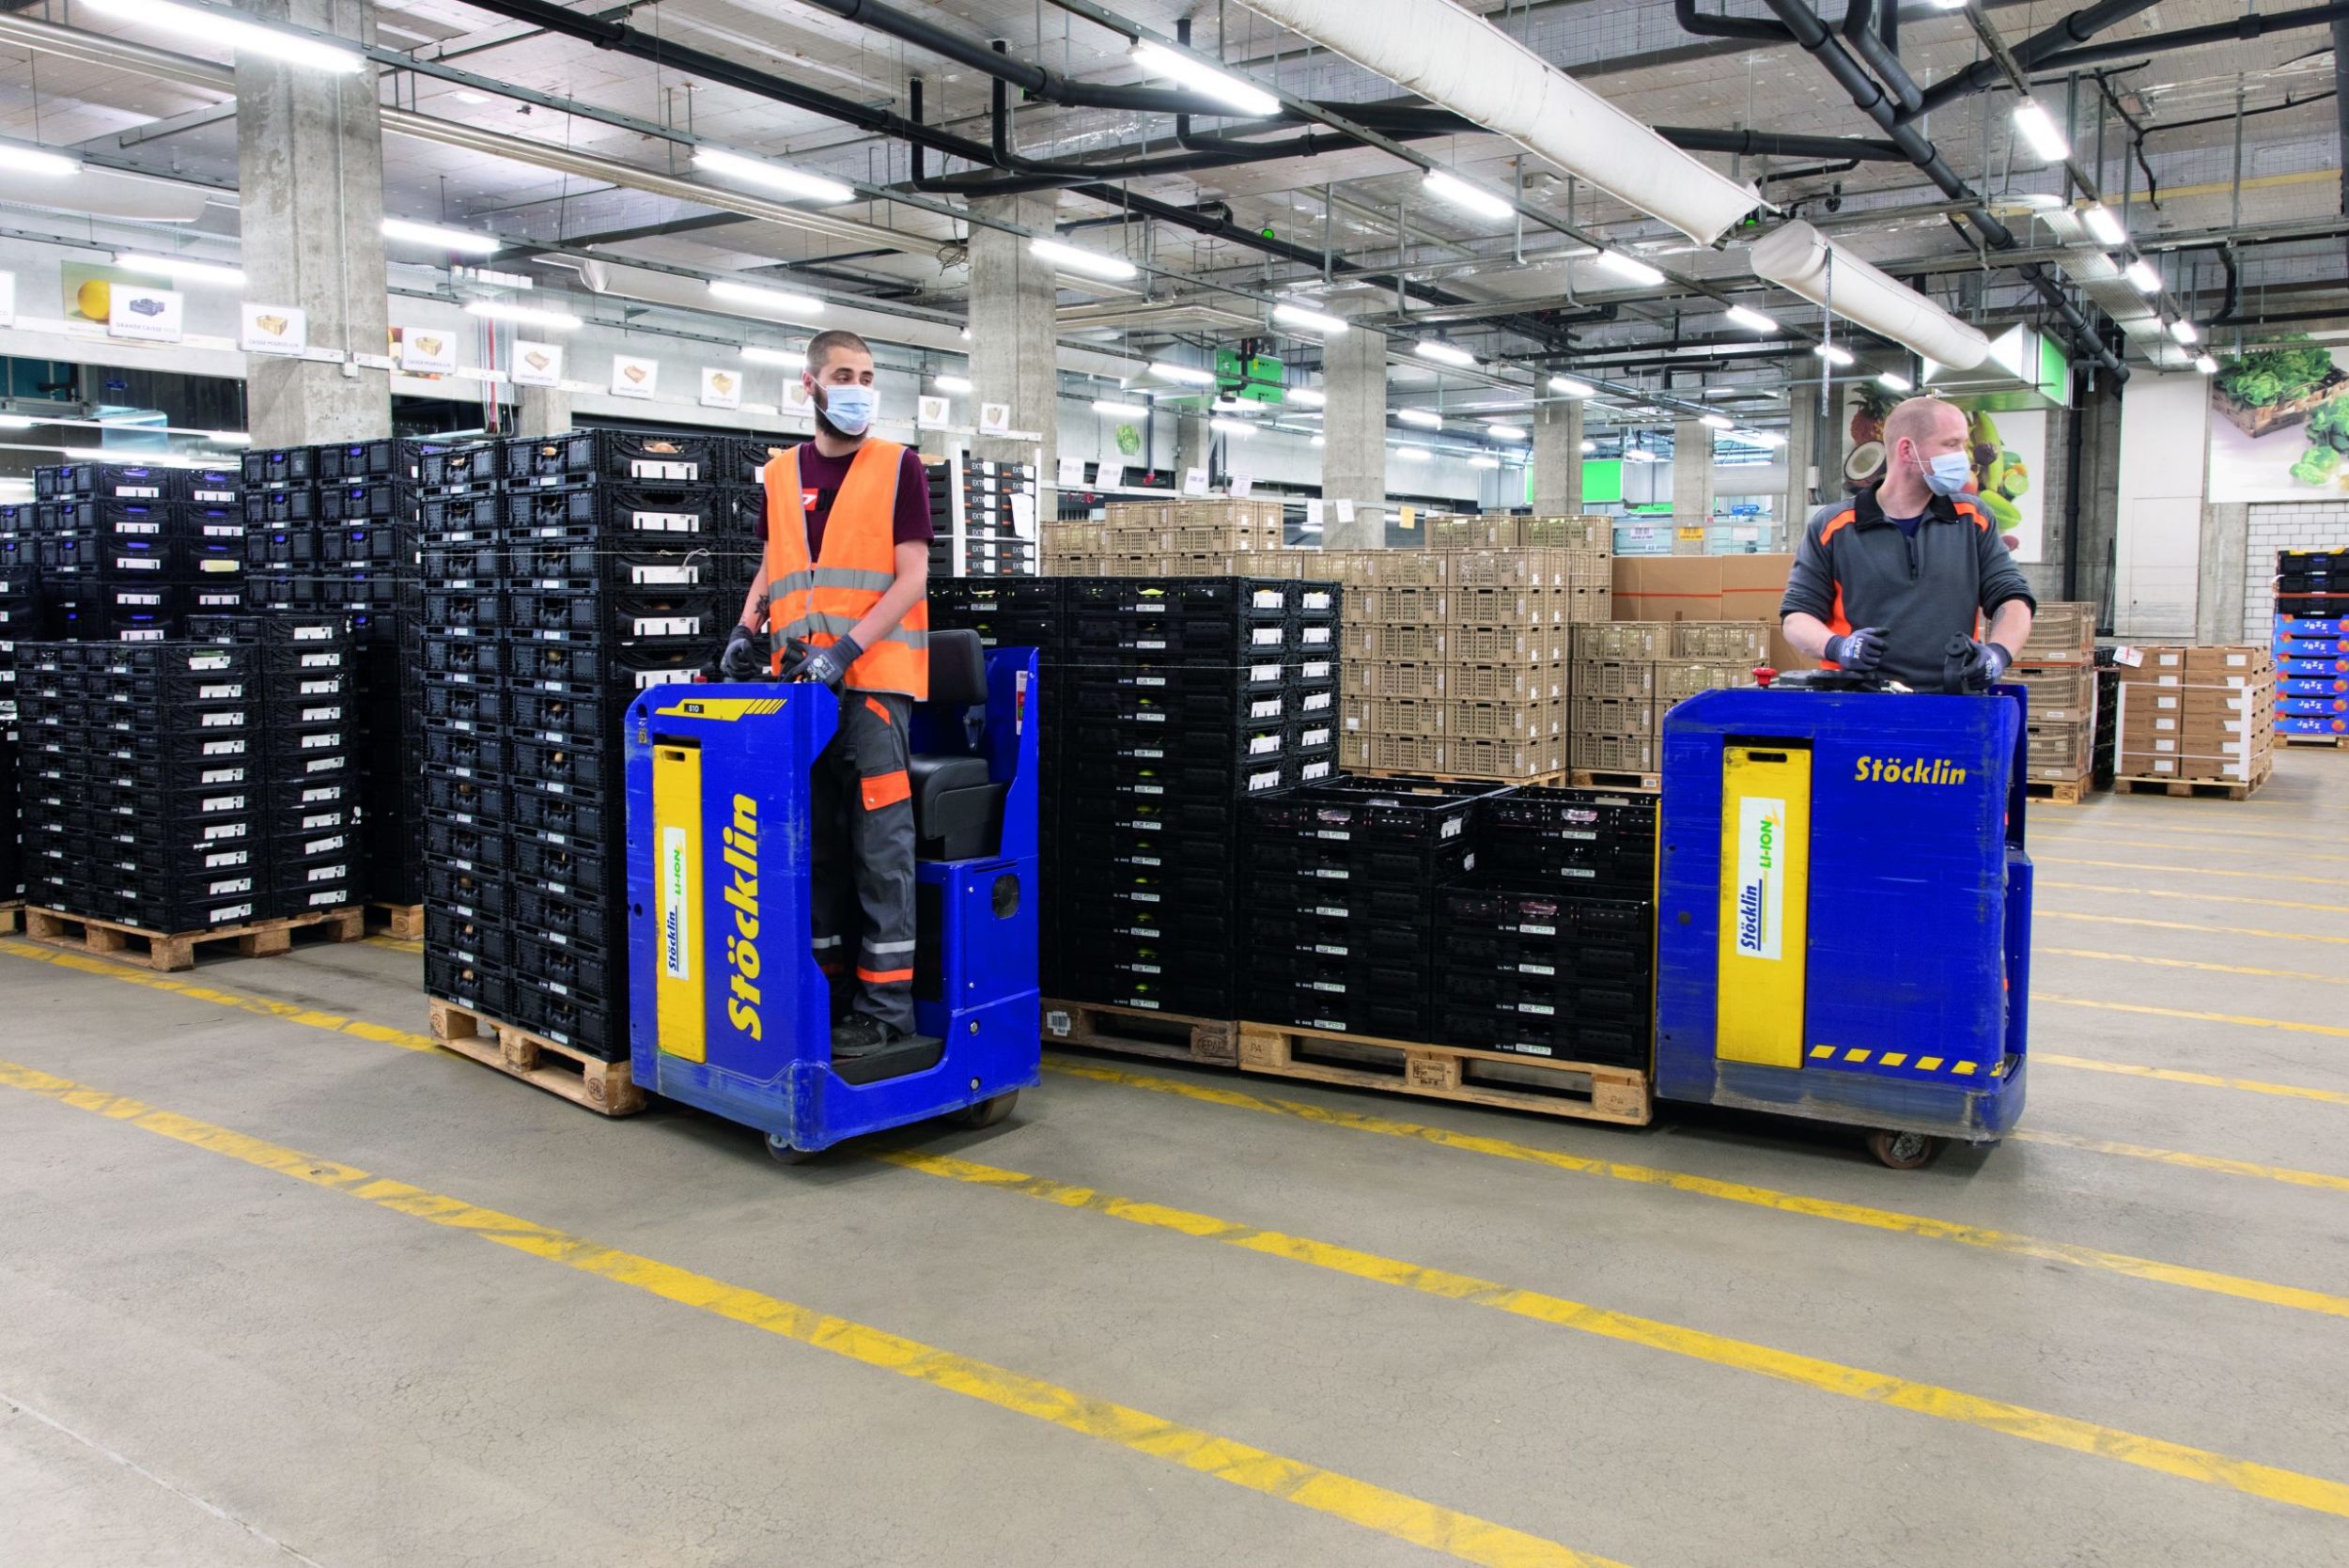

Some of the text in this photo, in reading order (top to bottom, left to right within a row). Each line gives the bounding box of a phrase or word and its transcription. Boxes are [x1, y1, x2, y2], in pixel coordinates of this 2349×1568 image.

[1854, 755, 1967, 785] Stöcklin
[1759, 819, 1773, 869] LI-ION
[673, 849, 681, 895] LI-ION
[667, 910, 677, 970] Stöcklin
[723, 793, 762, 1042] Stöcklin
[1741, 885, 1757, 950] Stöcklin
